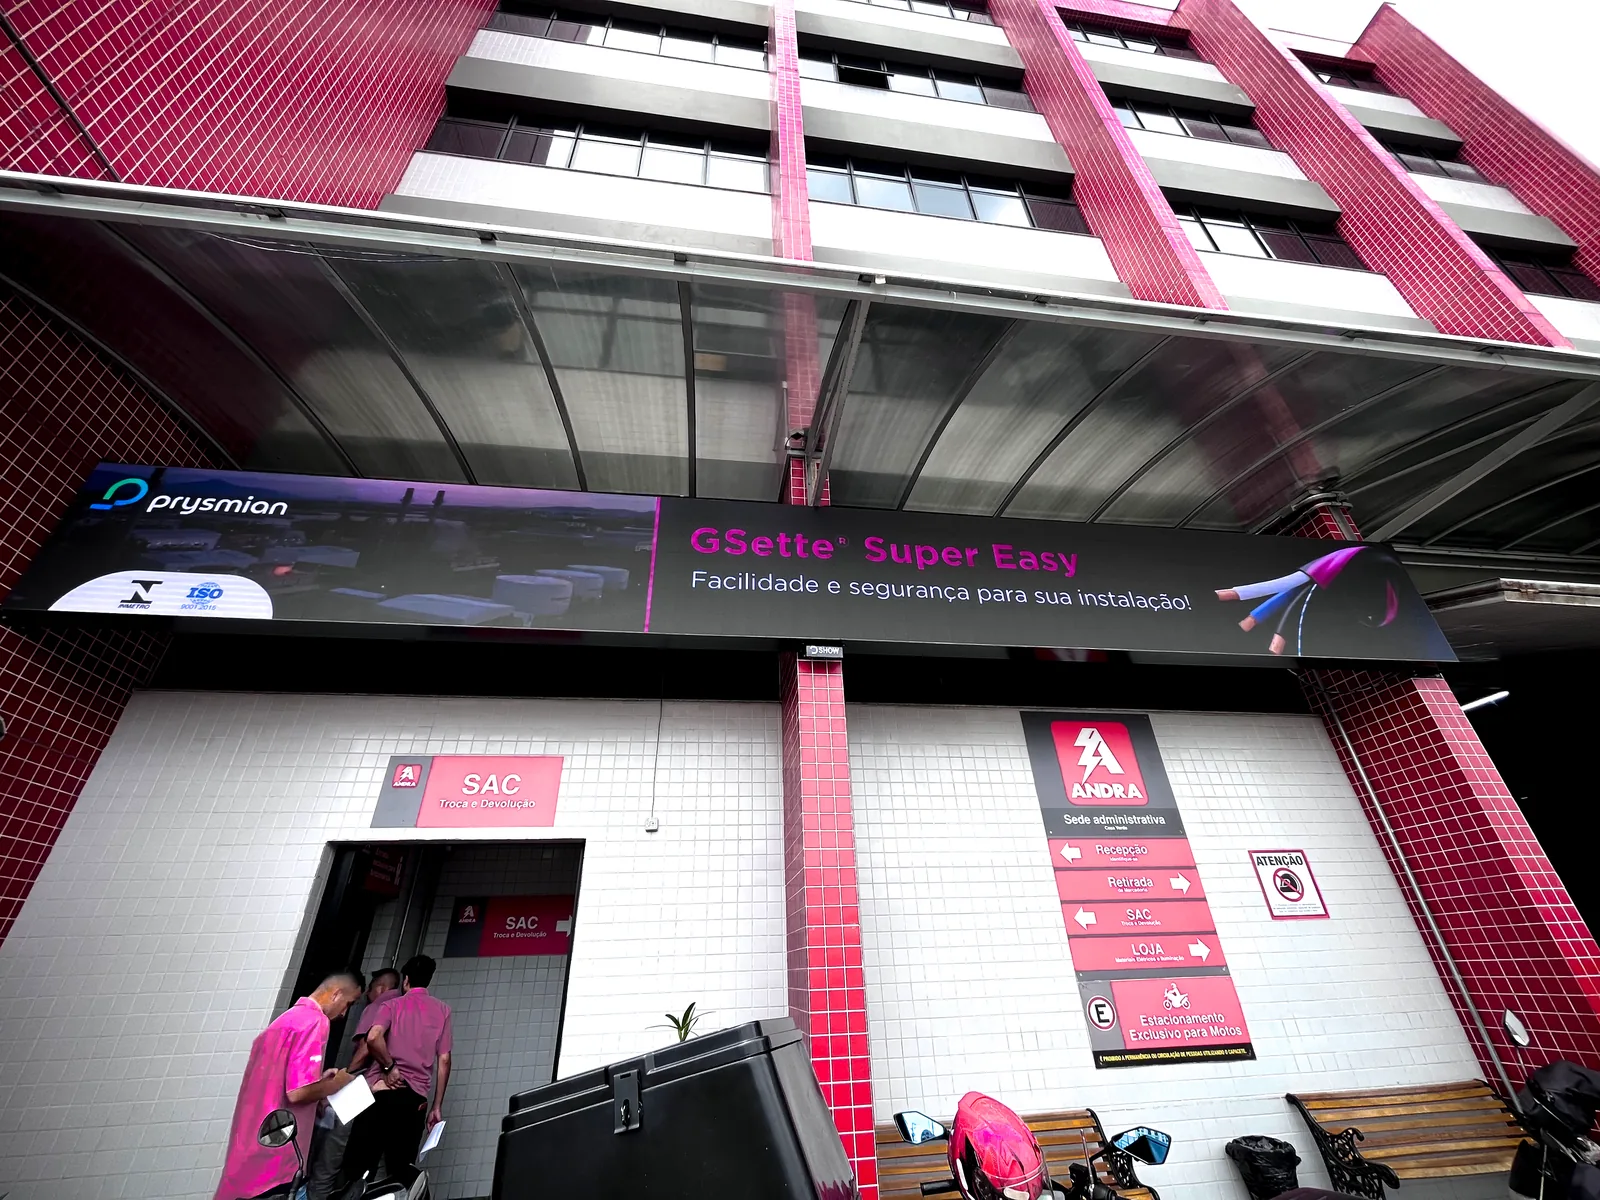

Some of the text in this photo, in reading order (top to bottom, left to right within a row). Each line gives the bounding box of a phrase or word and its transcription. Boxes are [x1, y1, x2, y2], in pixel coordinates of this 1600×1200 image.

[146, 495, 288, 516] prysmian
[864, 536, 979, 570] Super
[992, 543, 1078, 578] Easy
[186, 587, 224, 600] ISO
[692, 570, 1193, 611] Facilidade e segurança para sua instalação!
[462, 773, 522, 796] SAC
[1071, 782, 1144, 799] ANDRA
[439, 799, 468, 809] Troca
[480, 798, 536, 811] Devolução
[1063, 814, 1166, 825] Sede administrativa
[1095, 844, 1148, 856] Recepção
[1256, 853, 1304, 868] ATENÇÃO
[1107, 876, 1154, 888] Retirada
[1126, 908, 1152, 920] SAC
[505, 916, 539, 930] SAC
[516, 931, 547, 939] Devolução
[1131, 943, 1165, 956] LOJA
[1094, 1003, 1110, 1024] E
[1139, 1012, 1225, 1027] Estacionamento
[1129, 1025, 1243, 1041] Exclusivo para Motos
